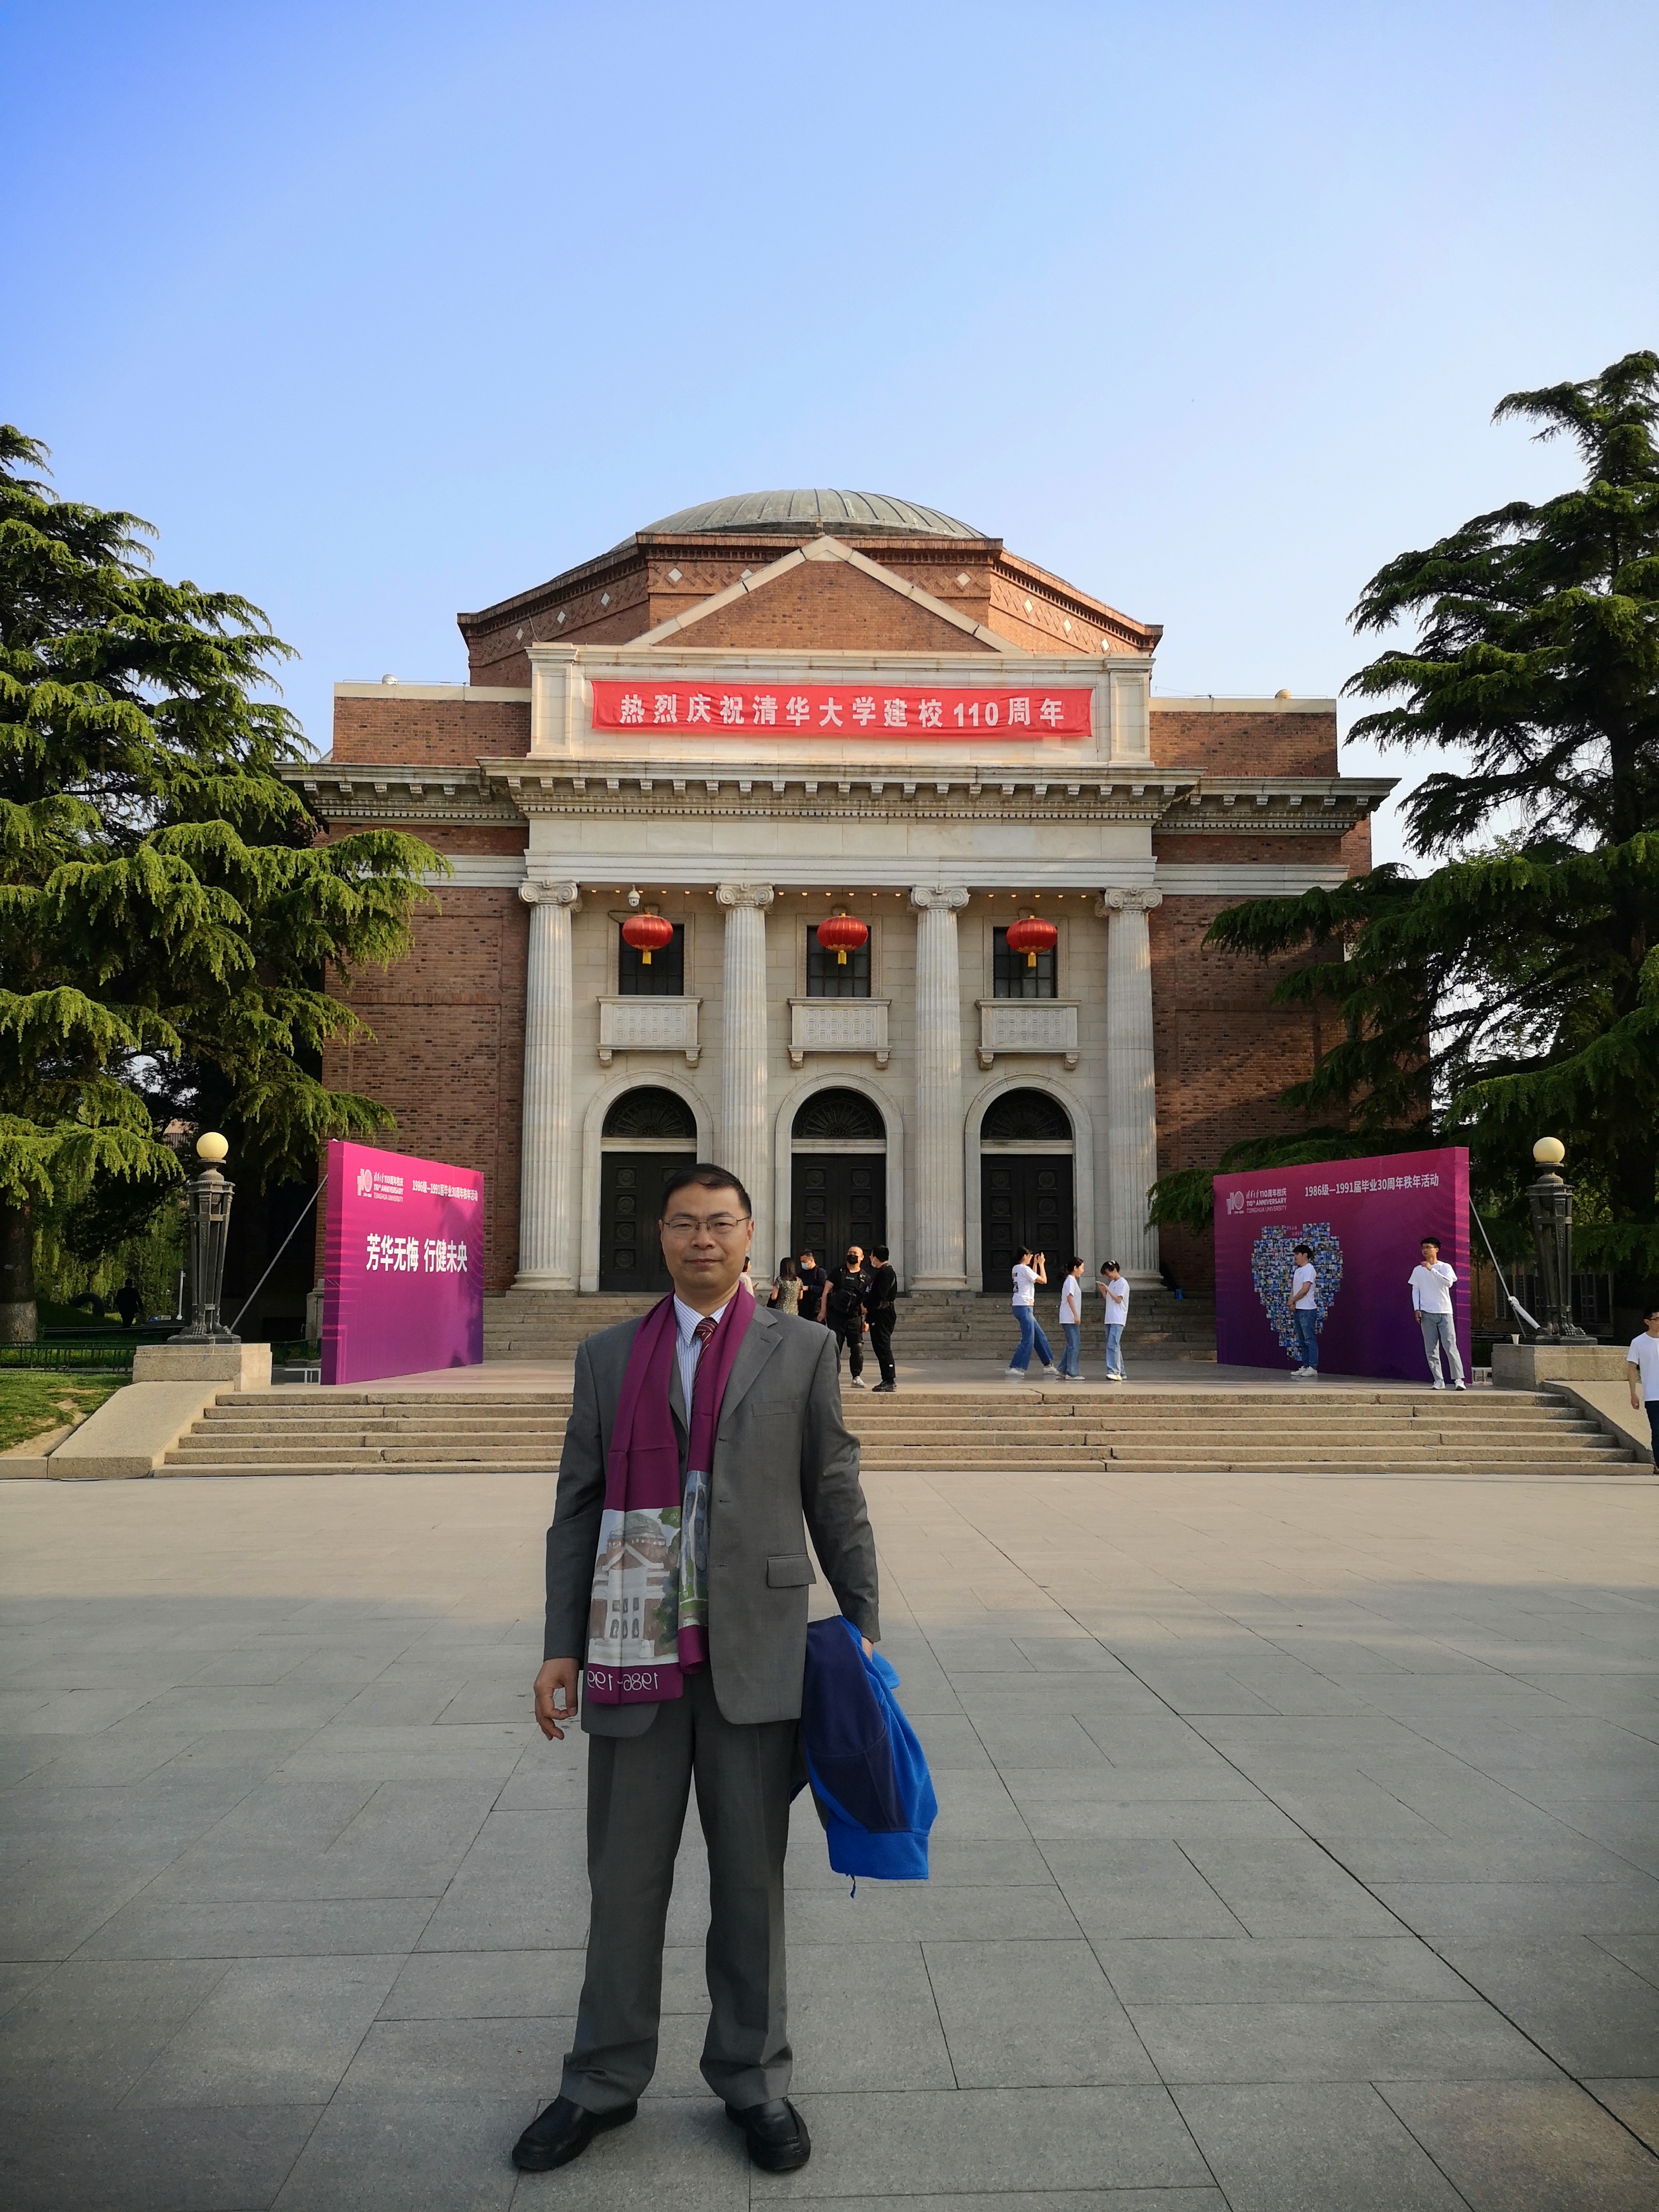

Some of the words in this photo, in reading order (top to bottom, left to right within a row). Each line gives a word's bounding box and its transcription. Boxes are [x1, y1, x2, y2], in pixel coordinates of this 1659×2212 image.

[619, 693, 1065, 727] 热烈庆祝清华大学建校110周年
[1255, 1197, 1287, 1206] ANNIVERSARY
[366, 1233, 419, 1272] 芳华无悔
[424, 1238, 468, 1273] 行健未央
